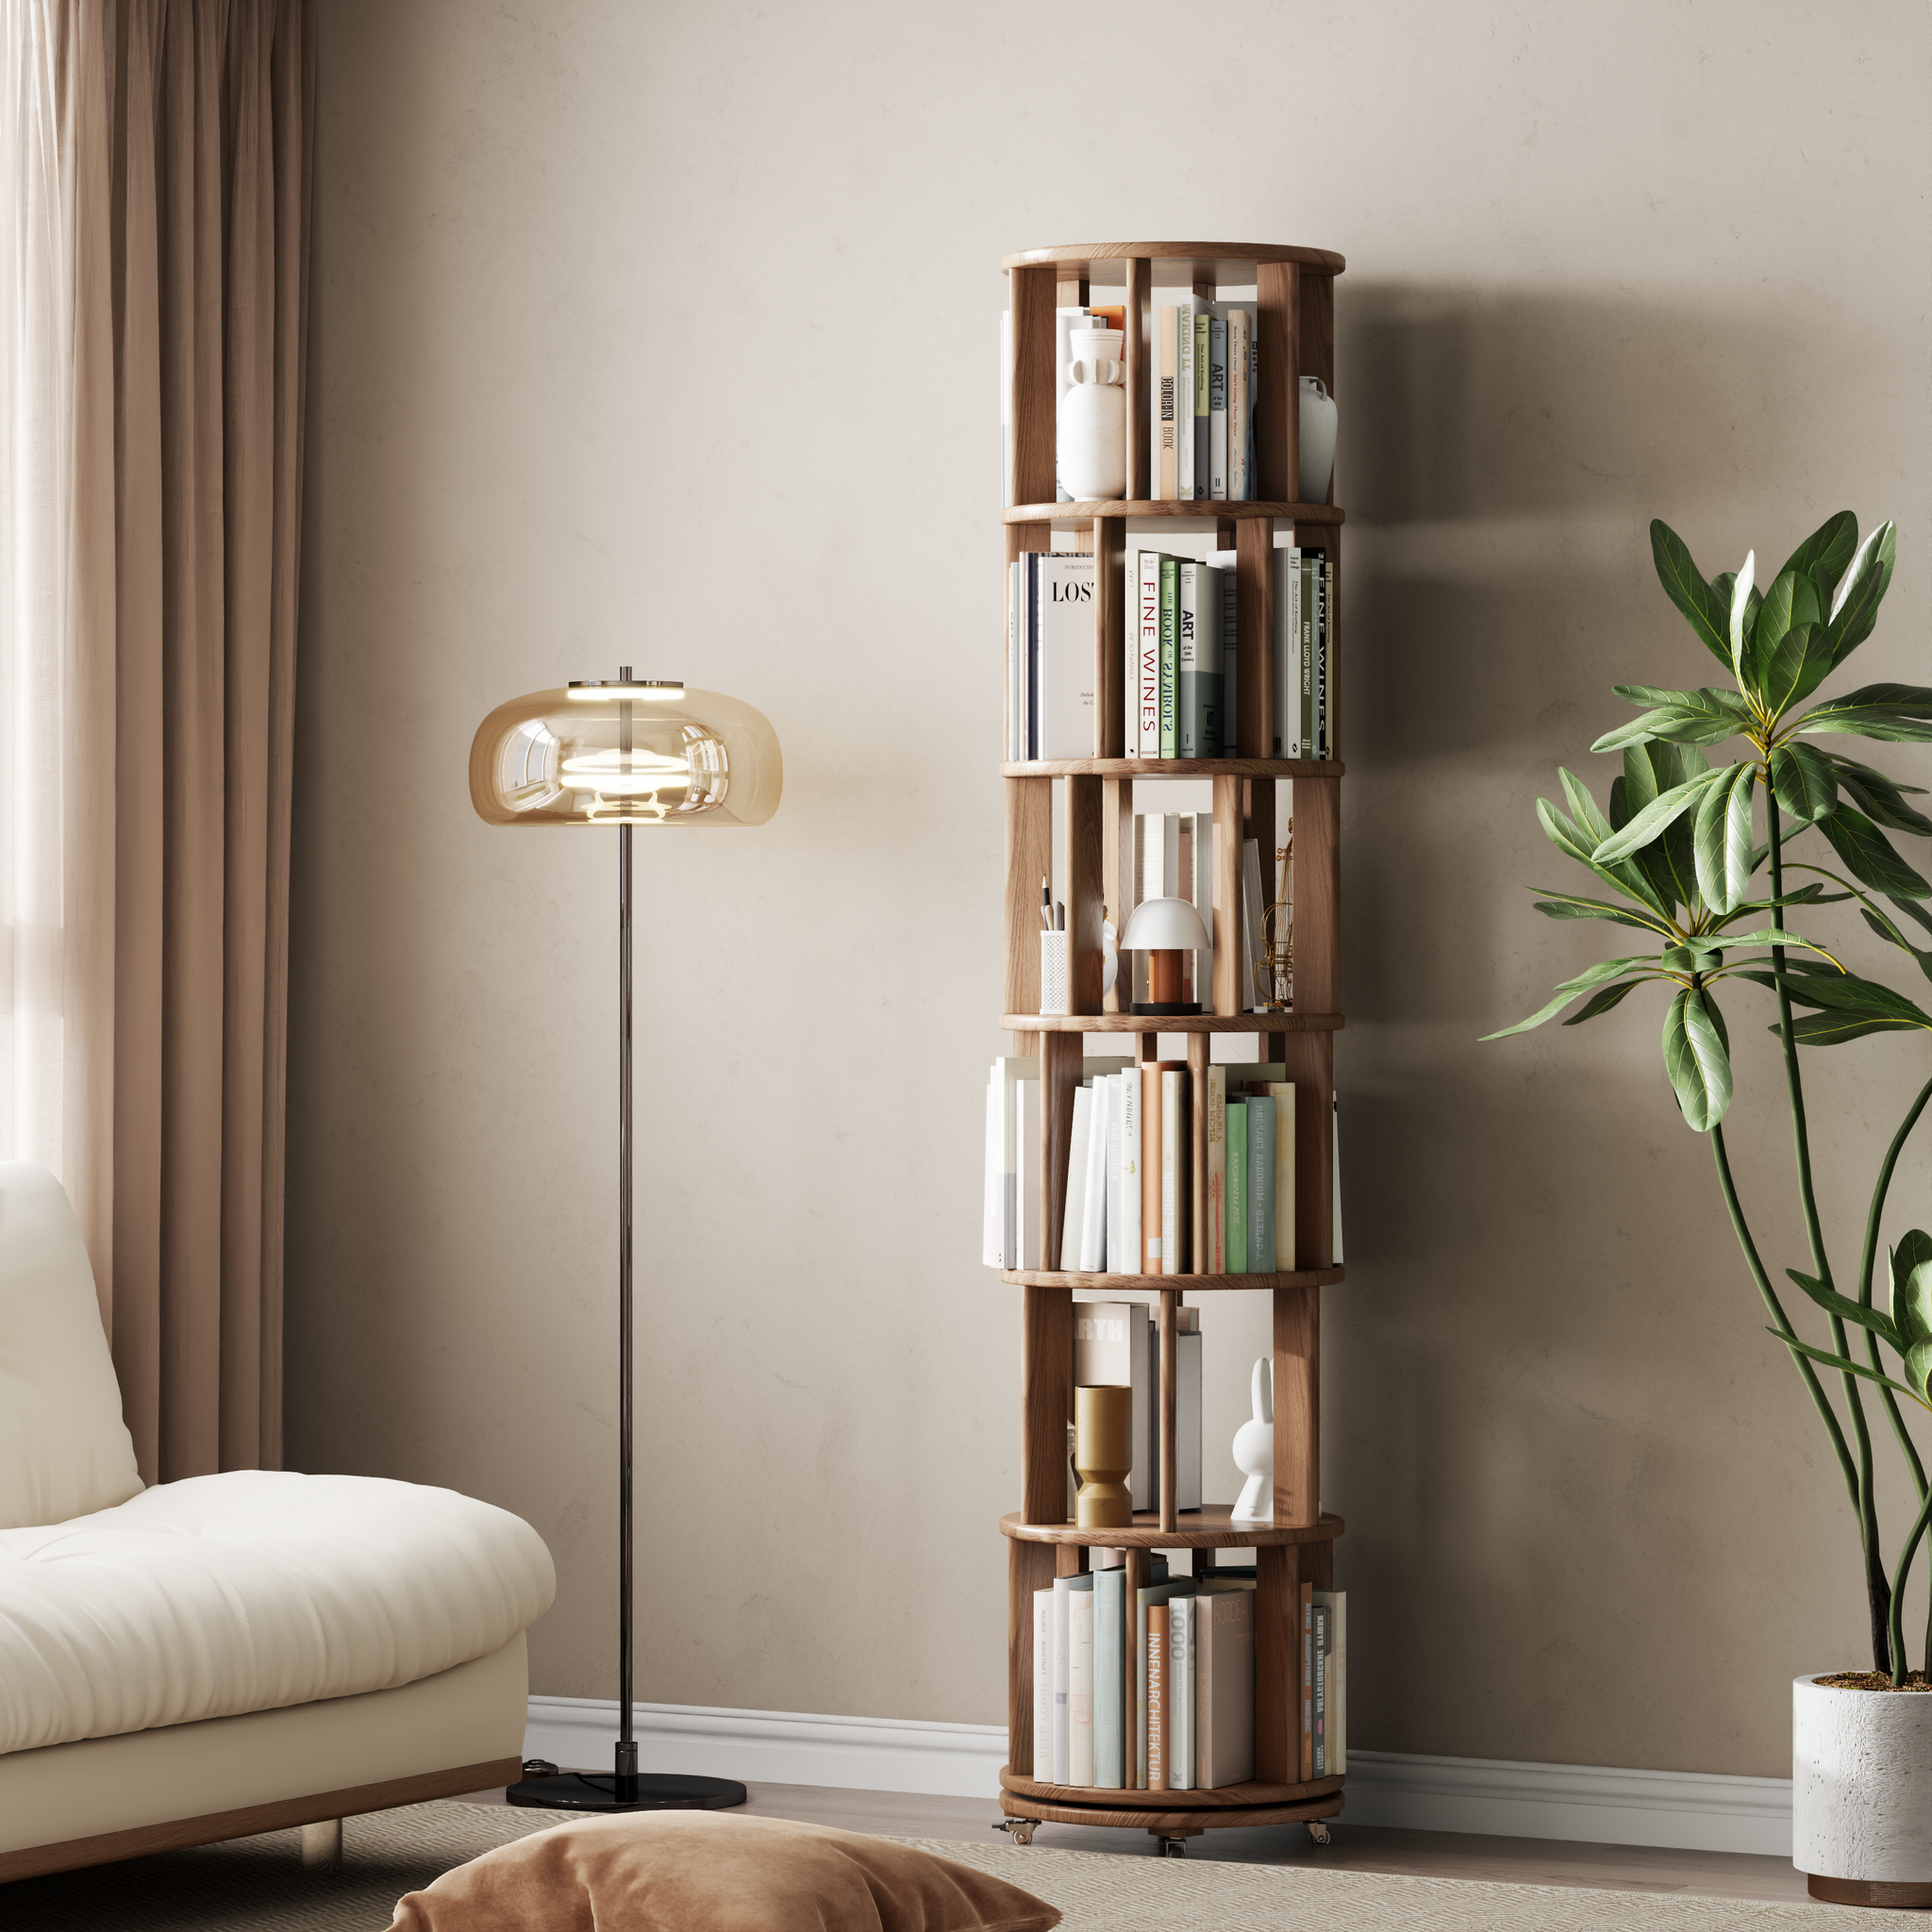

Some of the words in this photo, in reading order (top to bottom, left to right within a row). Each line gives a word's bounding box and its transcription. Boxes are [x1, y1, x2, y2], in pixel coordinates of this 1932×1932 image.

[1211, 363, 1224, 391] ART
[1162, 426, 1174, 450] BOOK
[1052, 581, 1094, 603] LOS
[1143, 582, 1156, 637] FINE
[1182, 610, 1194, 640] ART
[1143, 649, 1156, 731] WINES
[1110, 1122, 1119, 1141] ARNE
[1110, 1143, 1119, 1180] JACOBSEN
[1162, 1172, 1174, 1216] ONEGIN
[1162, 1219, 1174, 1266] EUGENE
[1074, 1318, 1124, 1341] RTH
[1171, 1605, 1186, 1661] 1000
[1148, 1633, 1161, 1781] INNENARCHITEKTUR
[1200, 1673, 1208, 1723] BORDEAUX
